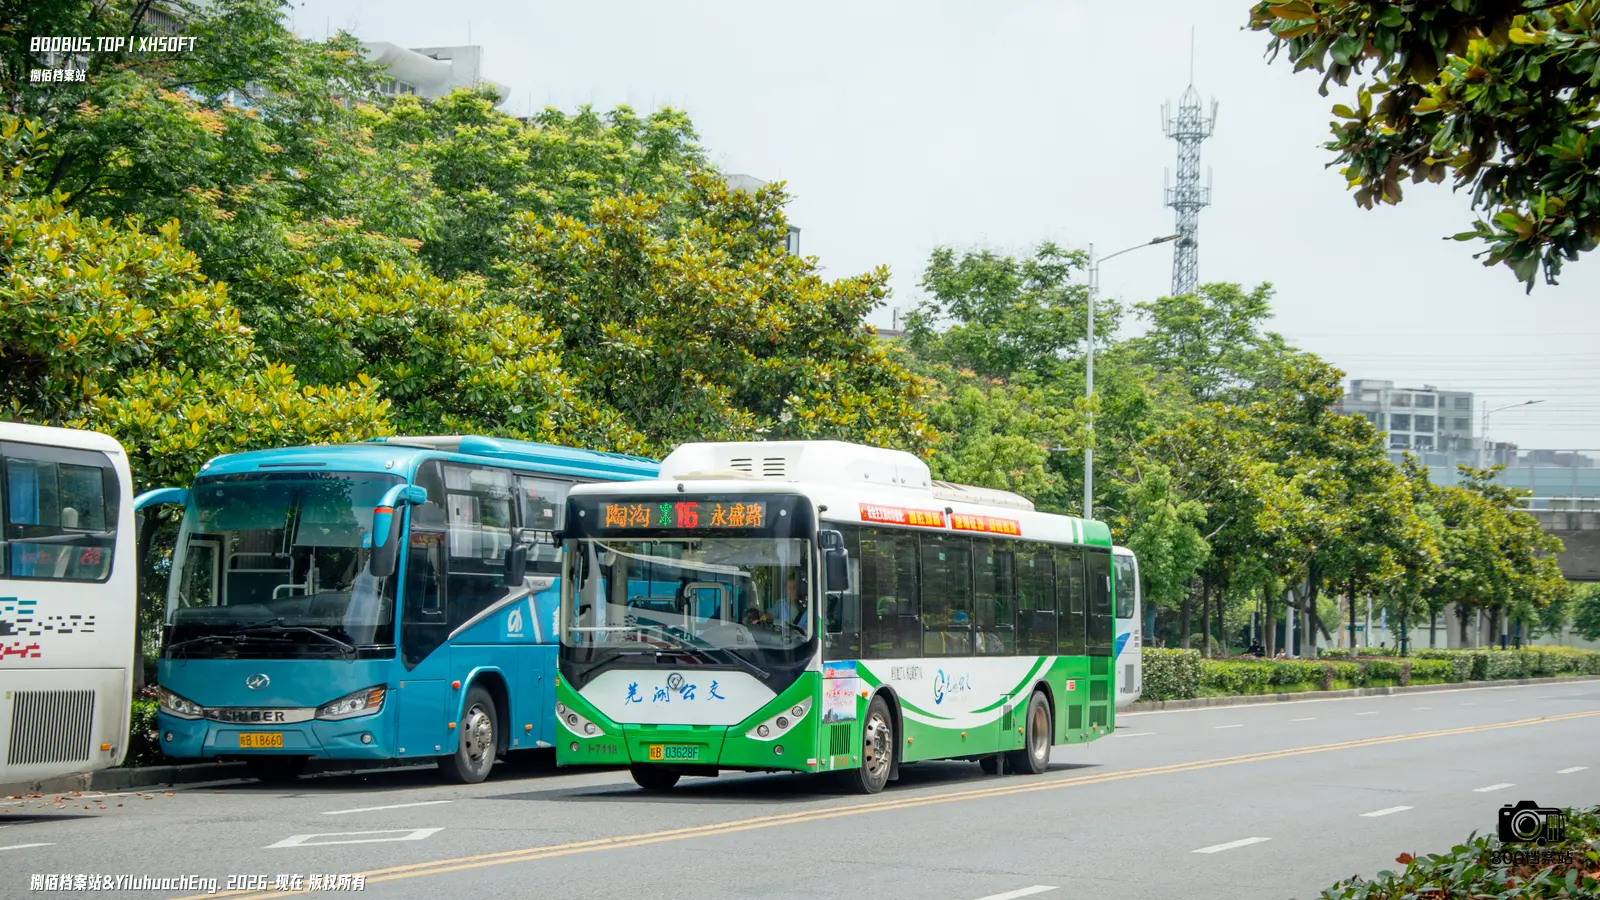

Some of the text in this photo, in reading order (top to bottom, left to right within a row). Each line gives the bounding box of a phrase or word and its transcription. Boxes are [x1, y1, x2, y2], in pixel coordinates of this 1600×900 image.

[605, 501, 764, 529] 陶沟 16 永盛路
[624, 680, 726, 706] 芜湖公交
[232, 711, 285, 722] HIGER
[665, 746, 699, 759] 03628F
